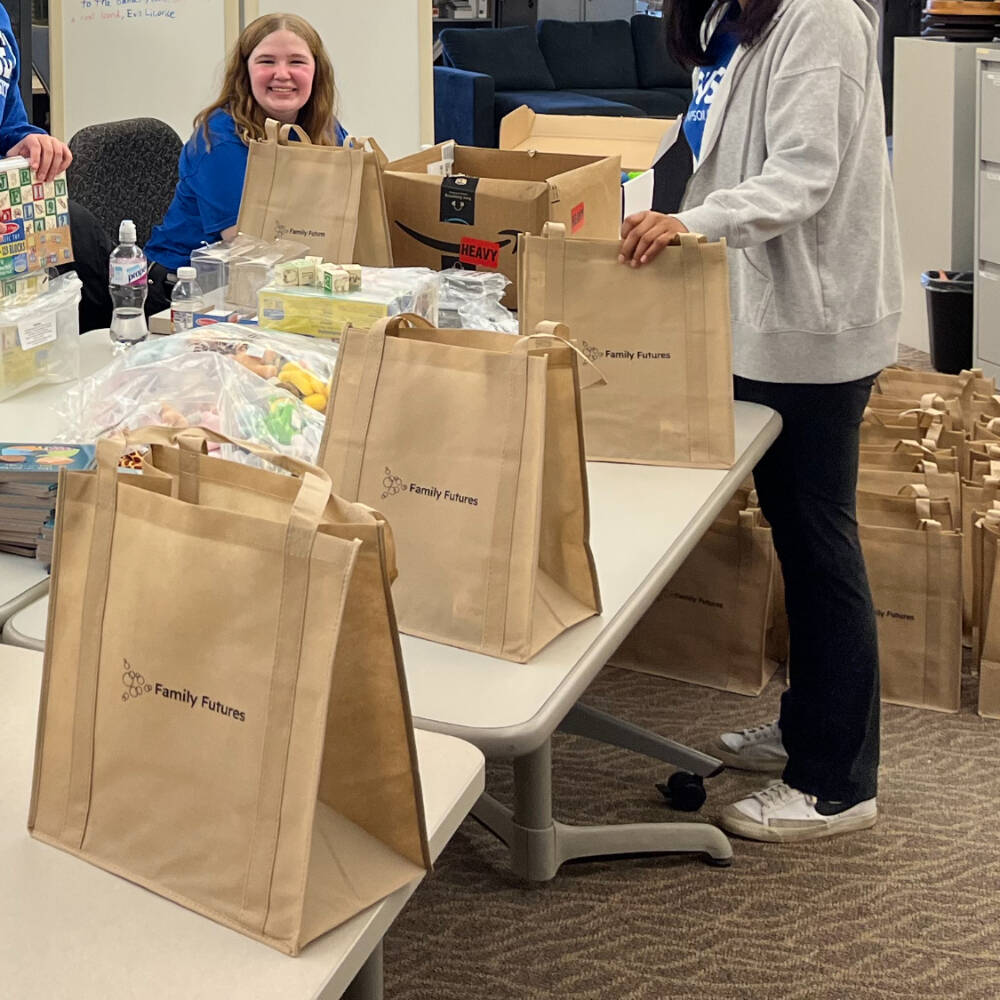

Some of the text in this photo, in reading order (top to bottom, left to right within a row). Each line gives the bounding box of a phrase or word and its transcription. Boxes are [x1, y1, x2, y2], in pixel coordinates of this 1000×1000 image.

[290, 228, 307, 236] Family
[461, 243, 498, 261] HEAVY
[605, 350, 671, 360] Family Futures
[409, 483, 478, 506] Family Futures
[155, 683, 246, 722] Family Futures
